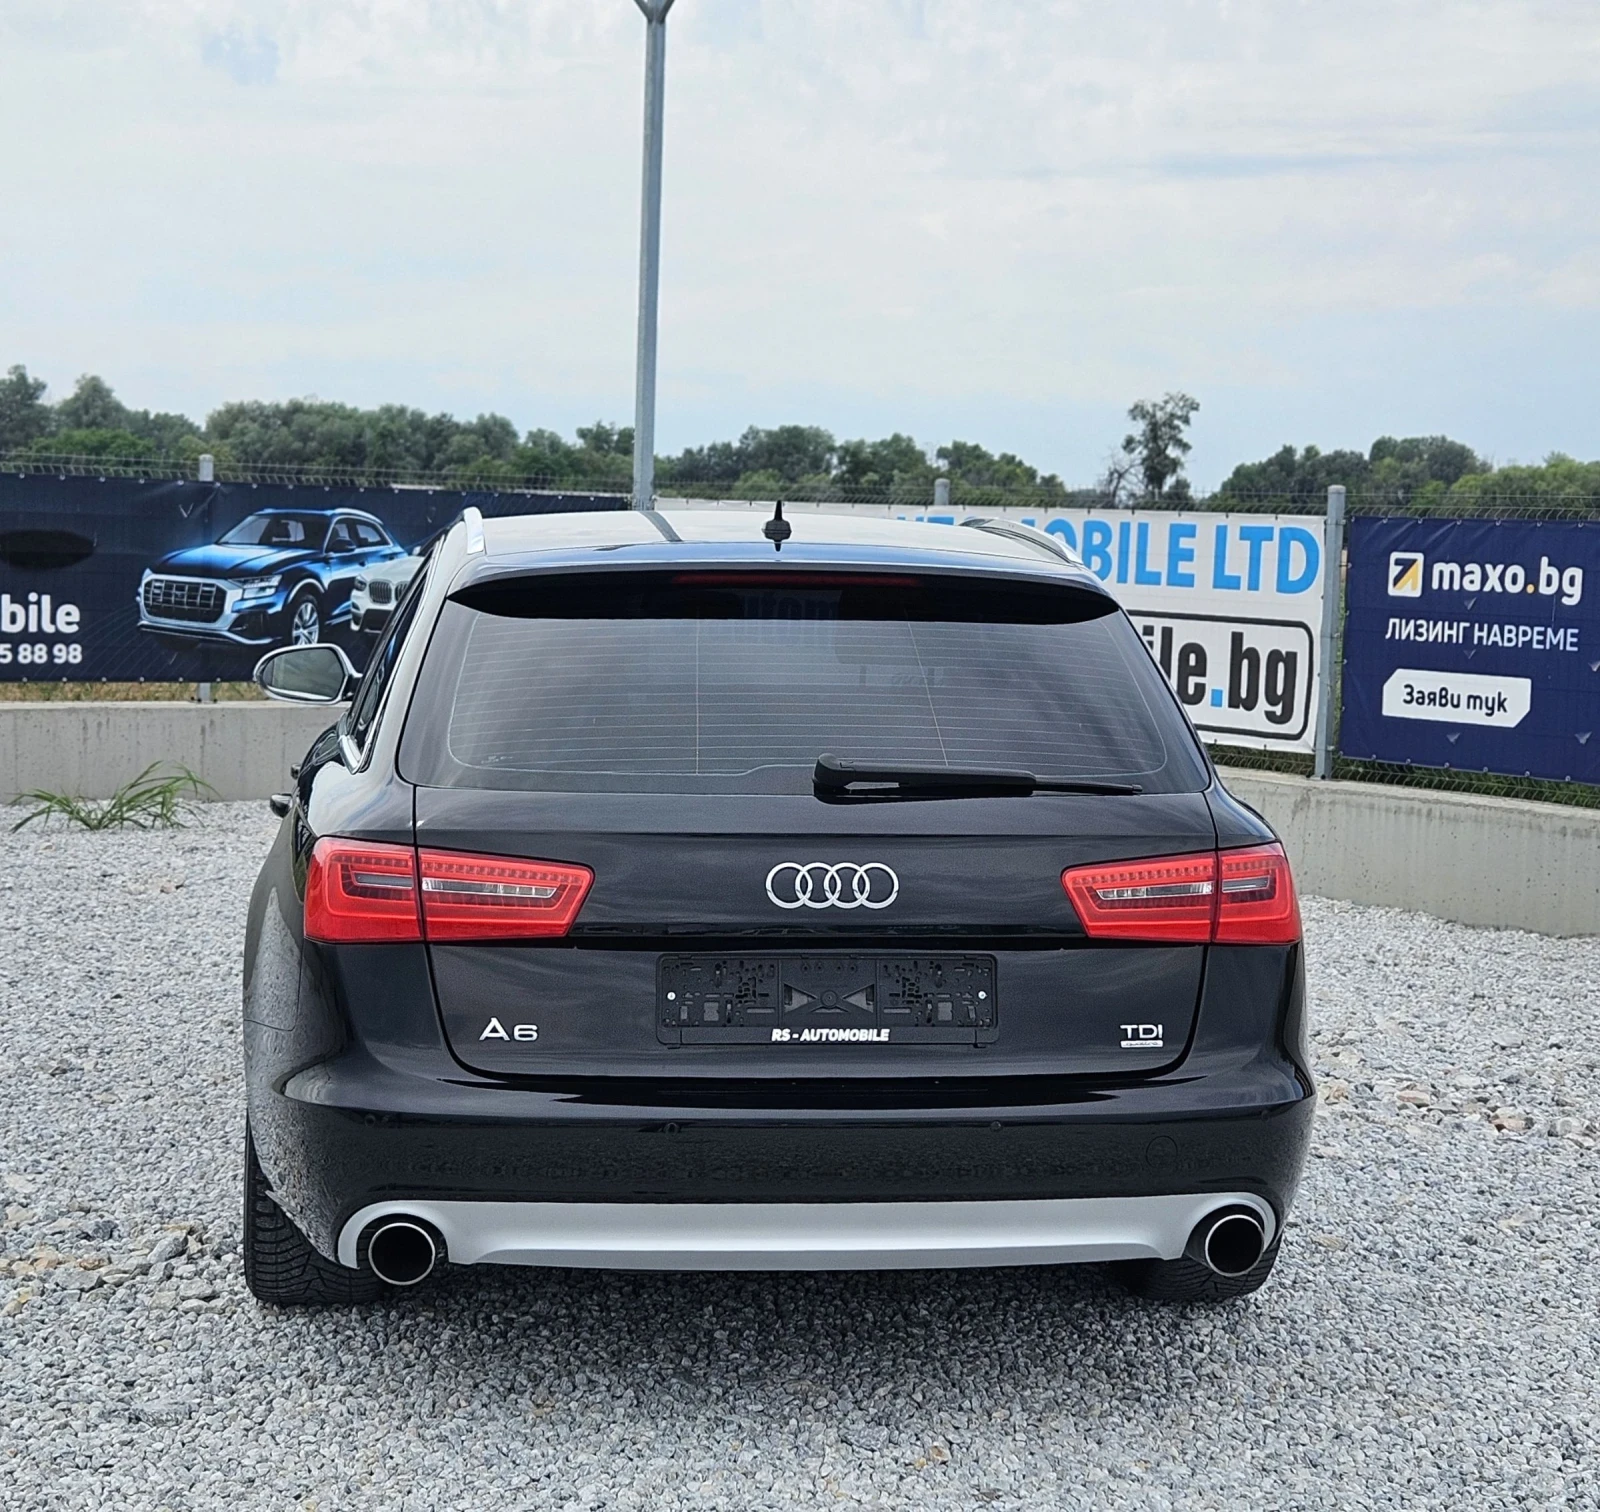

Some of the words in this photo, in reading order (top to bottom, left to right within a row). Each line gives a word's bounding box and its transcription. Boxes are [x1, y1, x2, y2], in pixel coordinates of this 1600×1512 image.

[1212, 524, 1320, 594] LTD
[1431, 556, 1583, 606] maxo.bg
[1, 592, 80, 634] bile
[1385, 618, 1470, 644] ЛИЗИНГ
[1473, 623, 1579, 652] НАВРЕМЕ
[17, 643, 48, 664] 88
[52, 643, 83, 664] 98
[1403, 684, 1461, 709] Заяви
[1466, 691, 1509, 716] тук
[479, 1016, 539, 1042] A6
[771, 1028, 792, 1042] RS
[800, 1028, 890, 1042] AUTOMOBILE
[1120, 1024, 1163, 1039] TDI
